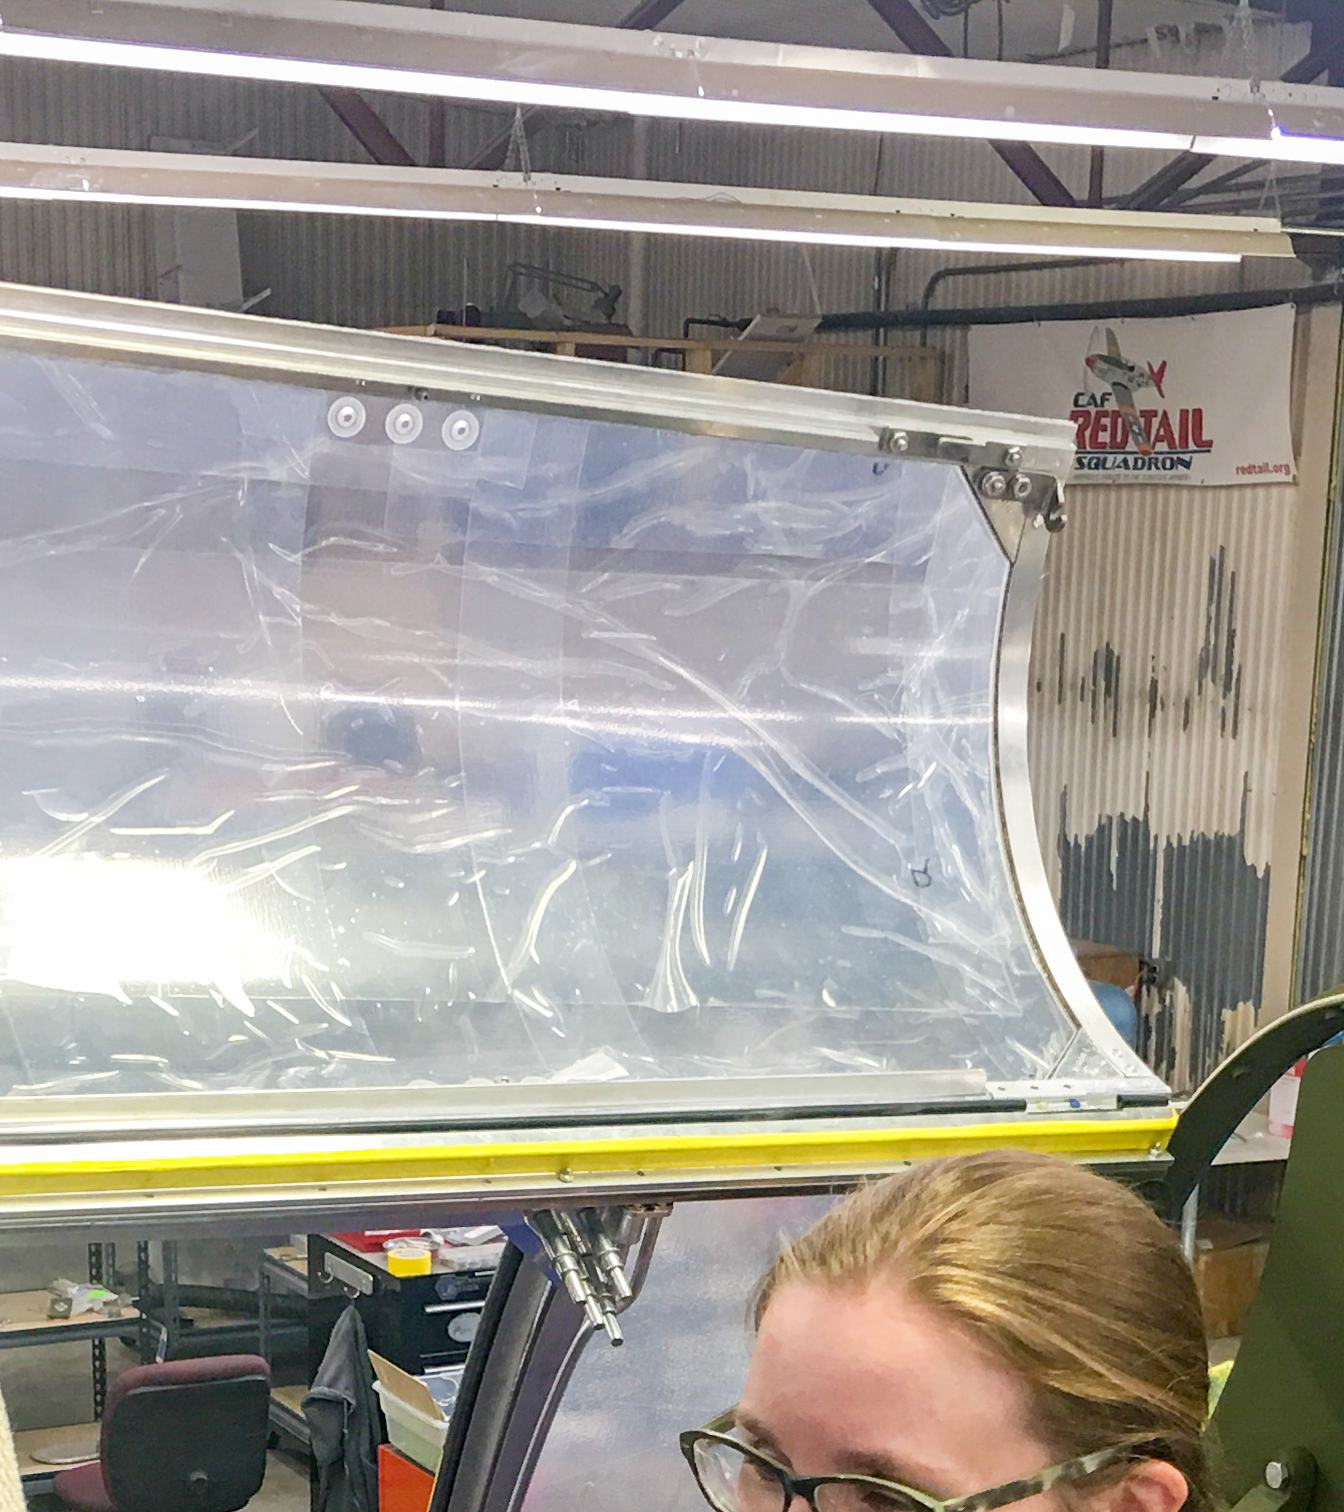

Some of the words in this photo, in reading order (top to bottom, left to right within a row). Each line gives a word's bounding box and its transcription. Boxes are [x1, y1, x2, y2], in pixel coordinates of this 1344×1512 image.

[1073, 392, 1112, 408] CAF
[1074, 456, 1193, 471] SQUADRON
[1235, 462, 1290, 476] redtail.org
